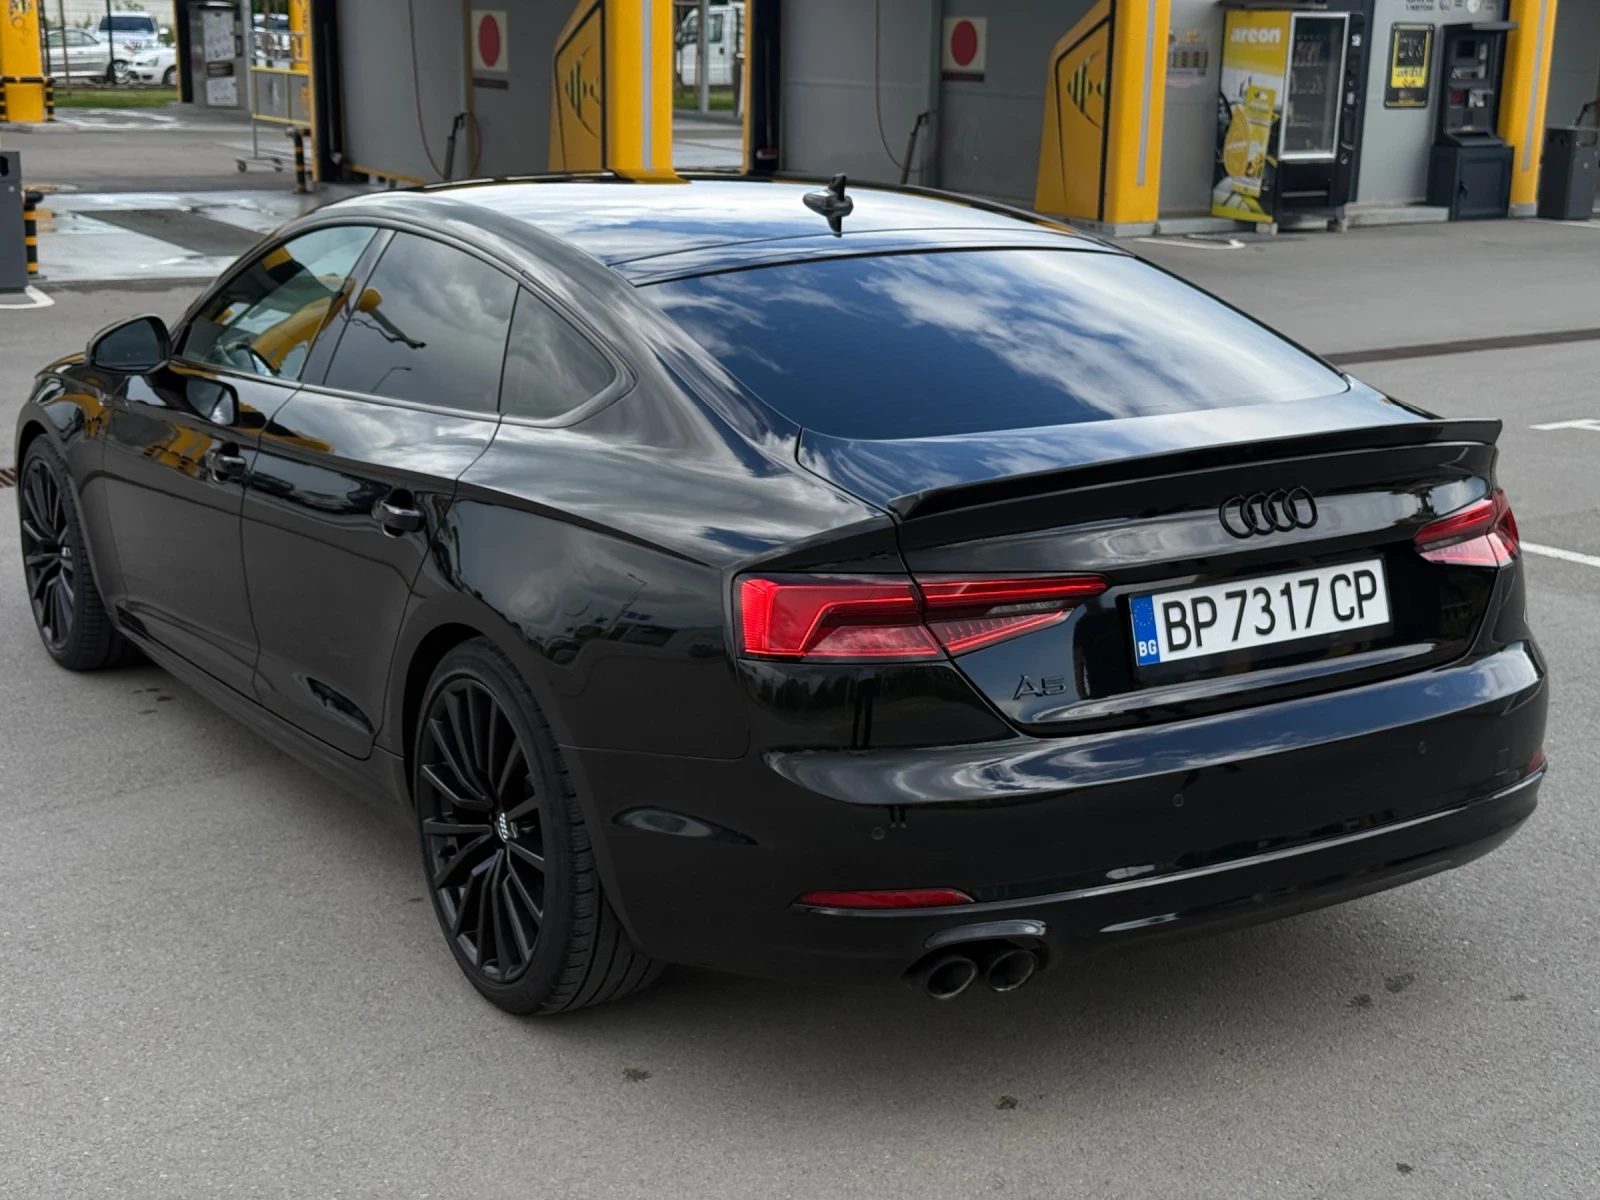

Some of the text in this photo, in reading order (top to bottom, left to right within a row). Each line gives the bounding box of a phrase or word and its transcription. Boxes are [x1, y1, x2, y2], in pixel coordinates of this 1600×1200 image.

[1230, 28, 1282, 43] areon
[1162, 569, 1377, 653] BP 7317 CP
[1138, 639, 1158, 657] BG
[1012, 674, 1067, 700] A5
